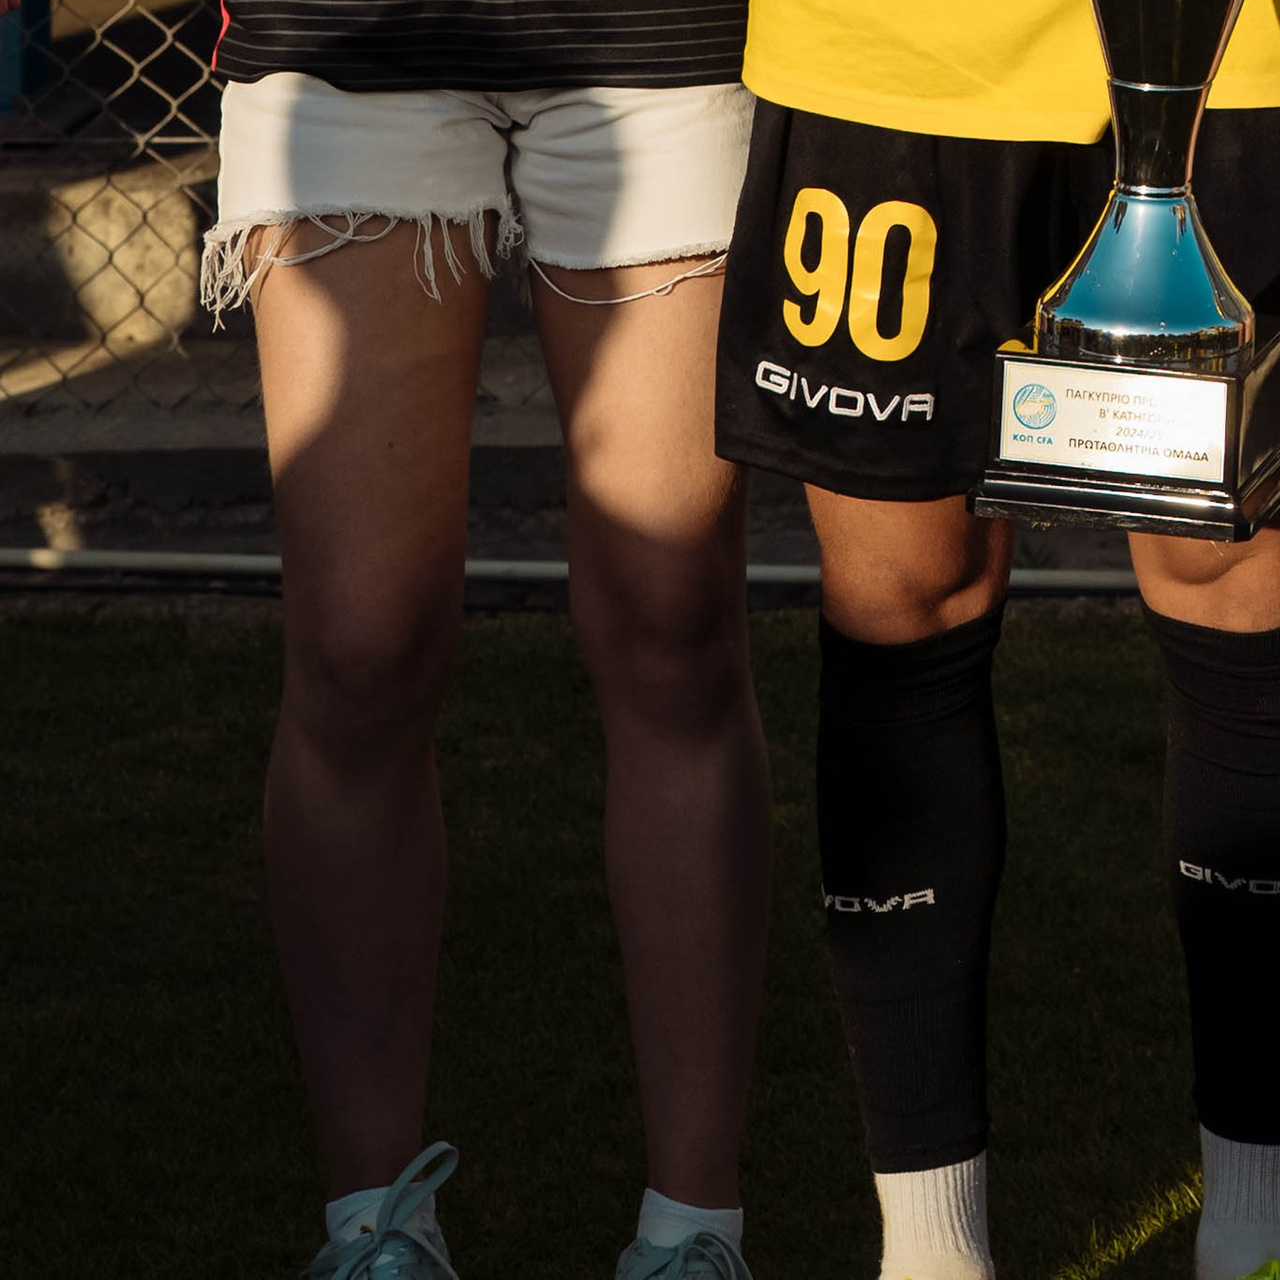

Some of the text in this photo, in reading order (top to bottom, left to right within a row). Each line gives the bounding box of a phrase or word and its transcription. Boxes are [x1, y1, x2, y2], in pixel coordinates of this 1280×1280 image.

[783, 187, 938, 362] 90
[755, 360, 935, 422] GIVOVA
[1036, 435, 1054, 445] CFA
